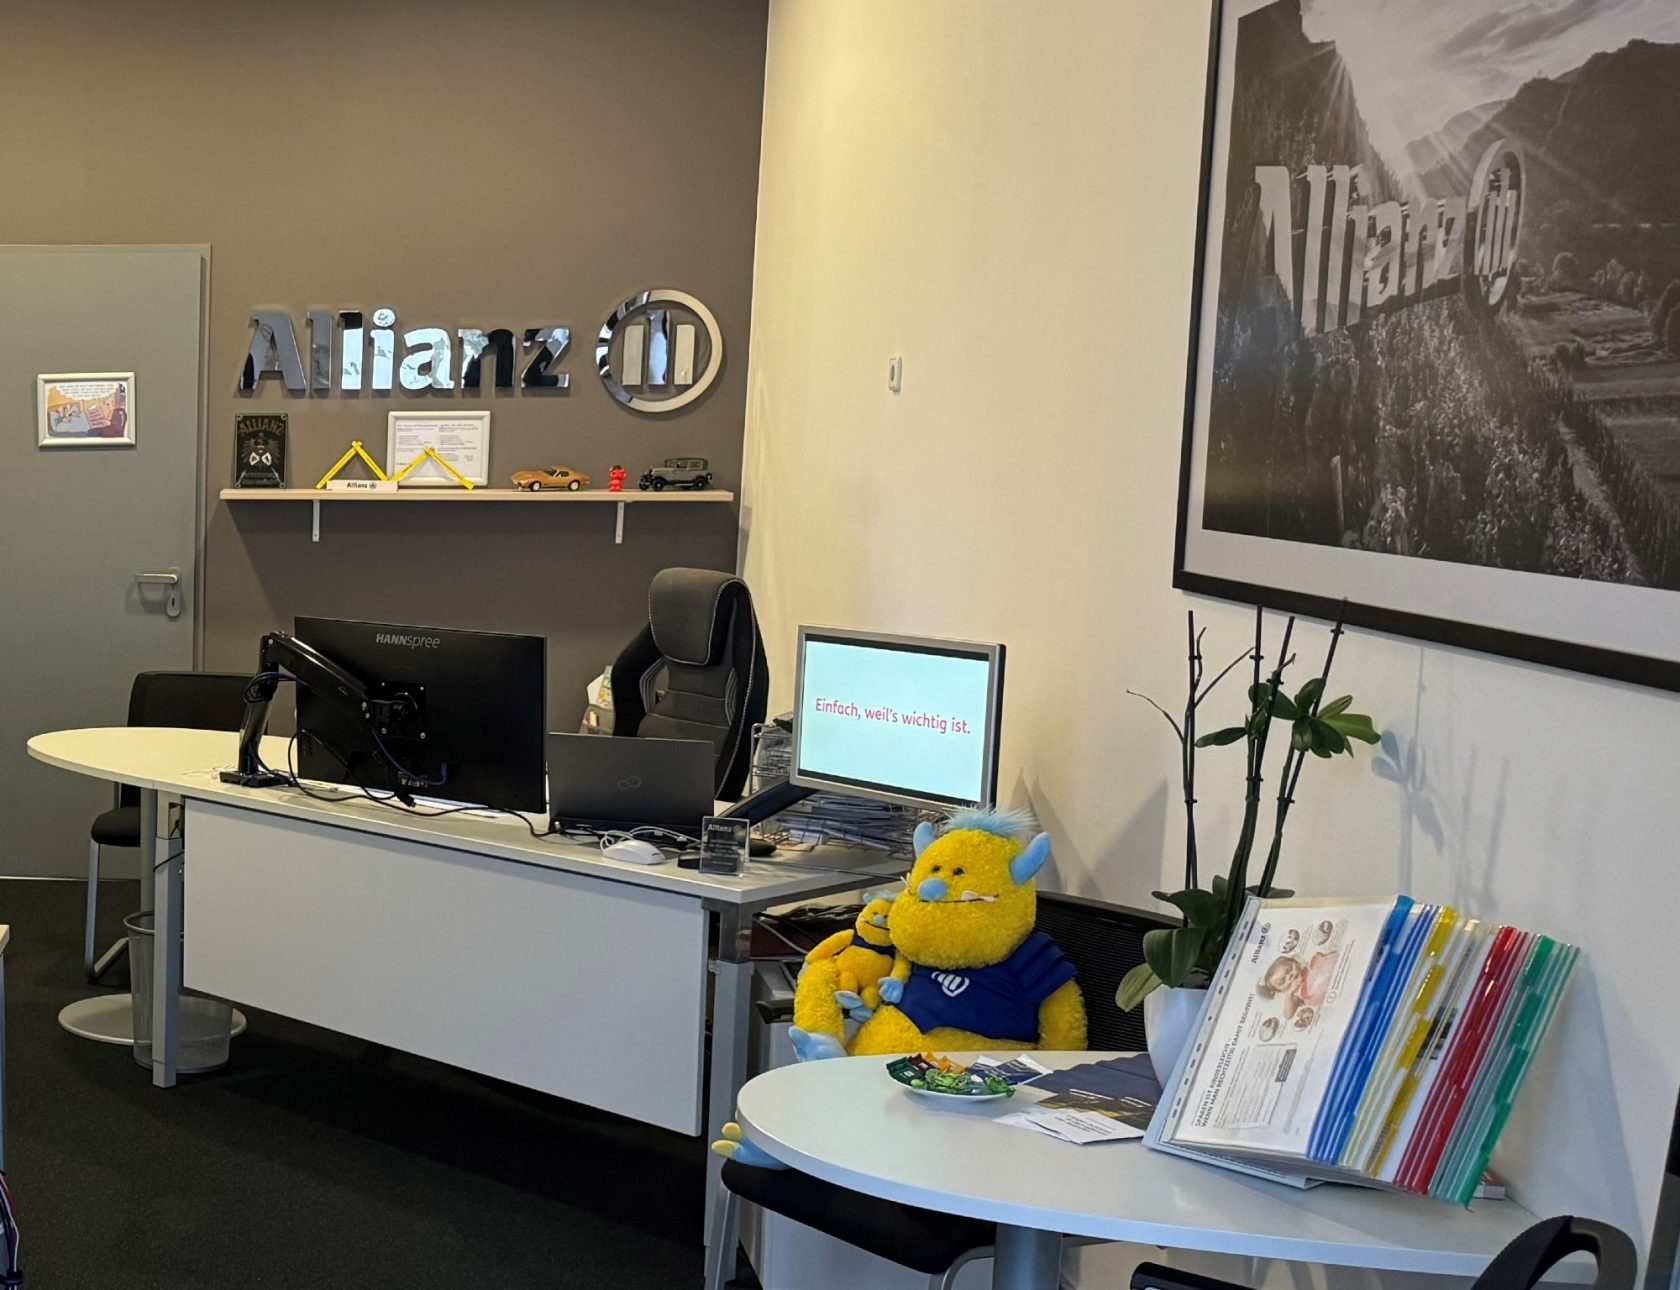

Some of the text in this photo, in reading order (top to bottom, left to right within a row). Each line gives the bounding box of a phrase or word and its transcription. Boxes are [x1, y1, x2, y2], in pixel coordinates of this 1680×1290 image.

[1251, 163, 1468, 337] Allianz
[239, 308, 571, 391] Allianz
[346, 481, 368, 489] Allianz
[375, 633, 441, 650] HANNspree
[815, 698, 861, 720] Einfach,
[902, 711, 948, 734] wichtig
[951, 717, 971, 734] ist.
